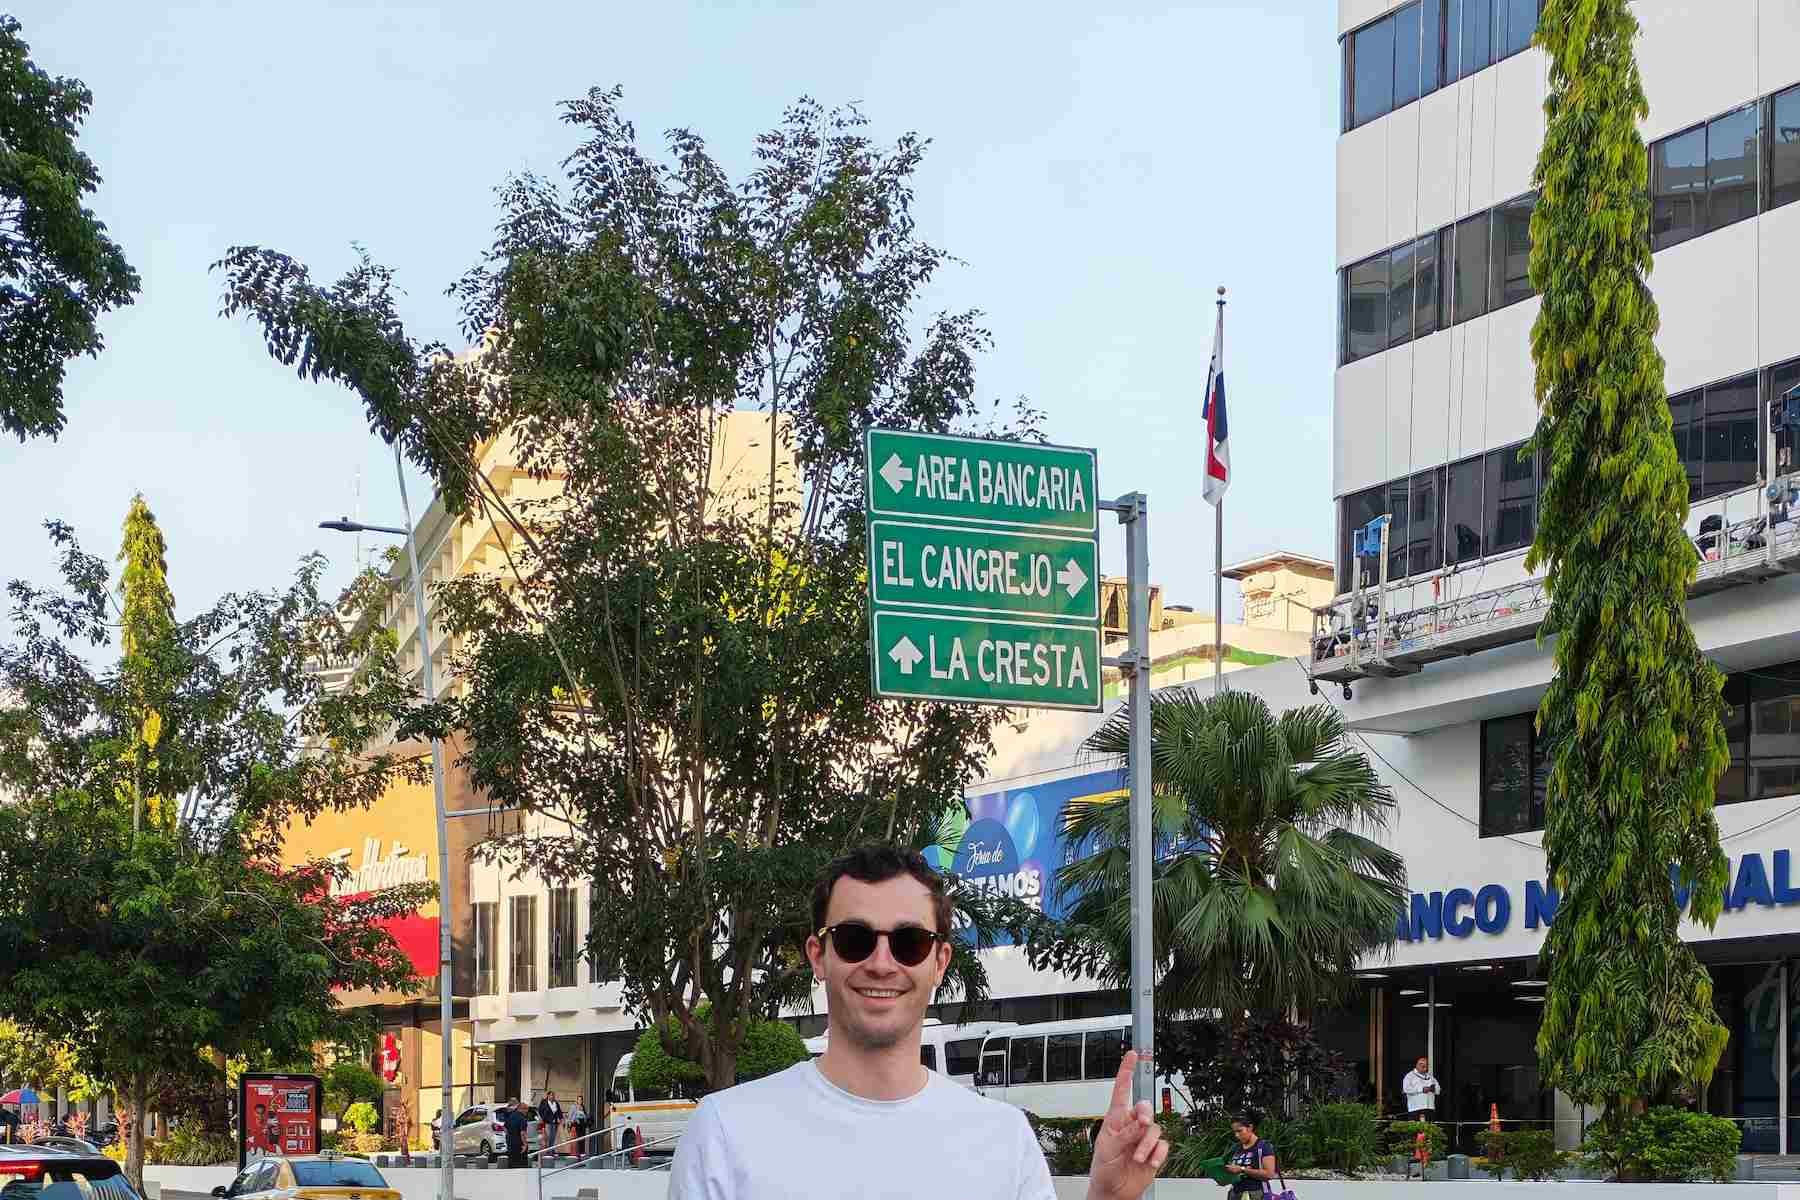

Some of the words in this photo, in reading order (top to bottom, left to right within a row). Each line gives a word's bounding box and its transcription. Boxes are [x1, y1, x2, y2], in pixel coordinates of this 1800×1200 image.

[915, 454, 975, 502] AREA
[978, 459, 1086, 512] BANCARIA
[882, 540, 914, 587] EL
[921, 544, 1052, 597] CANGREJO
[929, 634, 970, 681] LA
[977, 639, 1088, 689] CRESTA
